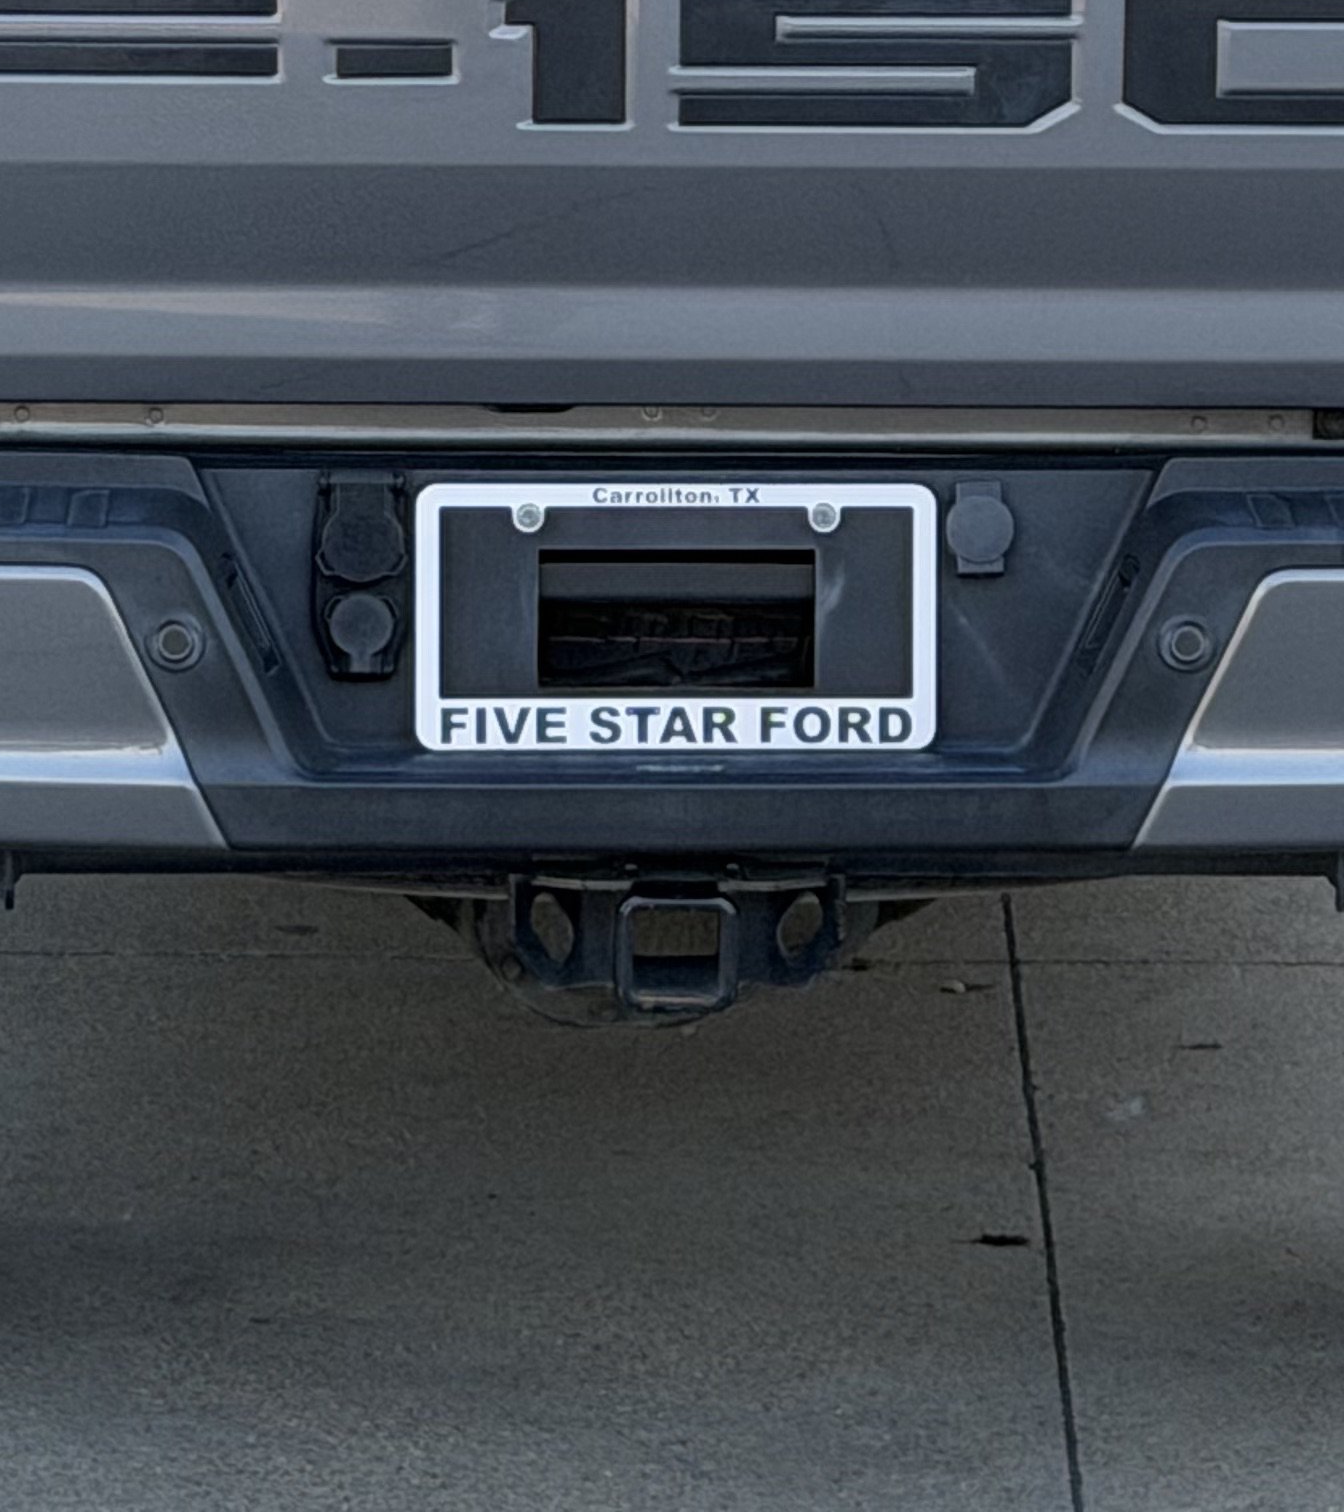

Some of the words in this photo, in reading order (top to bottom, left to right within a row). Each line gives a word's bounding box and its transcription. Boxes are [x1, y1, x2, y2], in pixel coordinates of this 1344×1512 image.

[592, 487, 720, 504] Carrollton,
[729, 487, 760, 504] TX
[440, 707, 567, 744] FIVE
[589, 706, 738, 744] STAR
[760, 706, 913, 744] FORD
